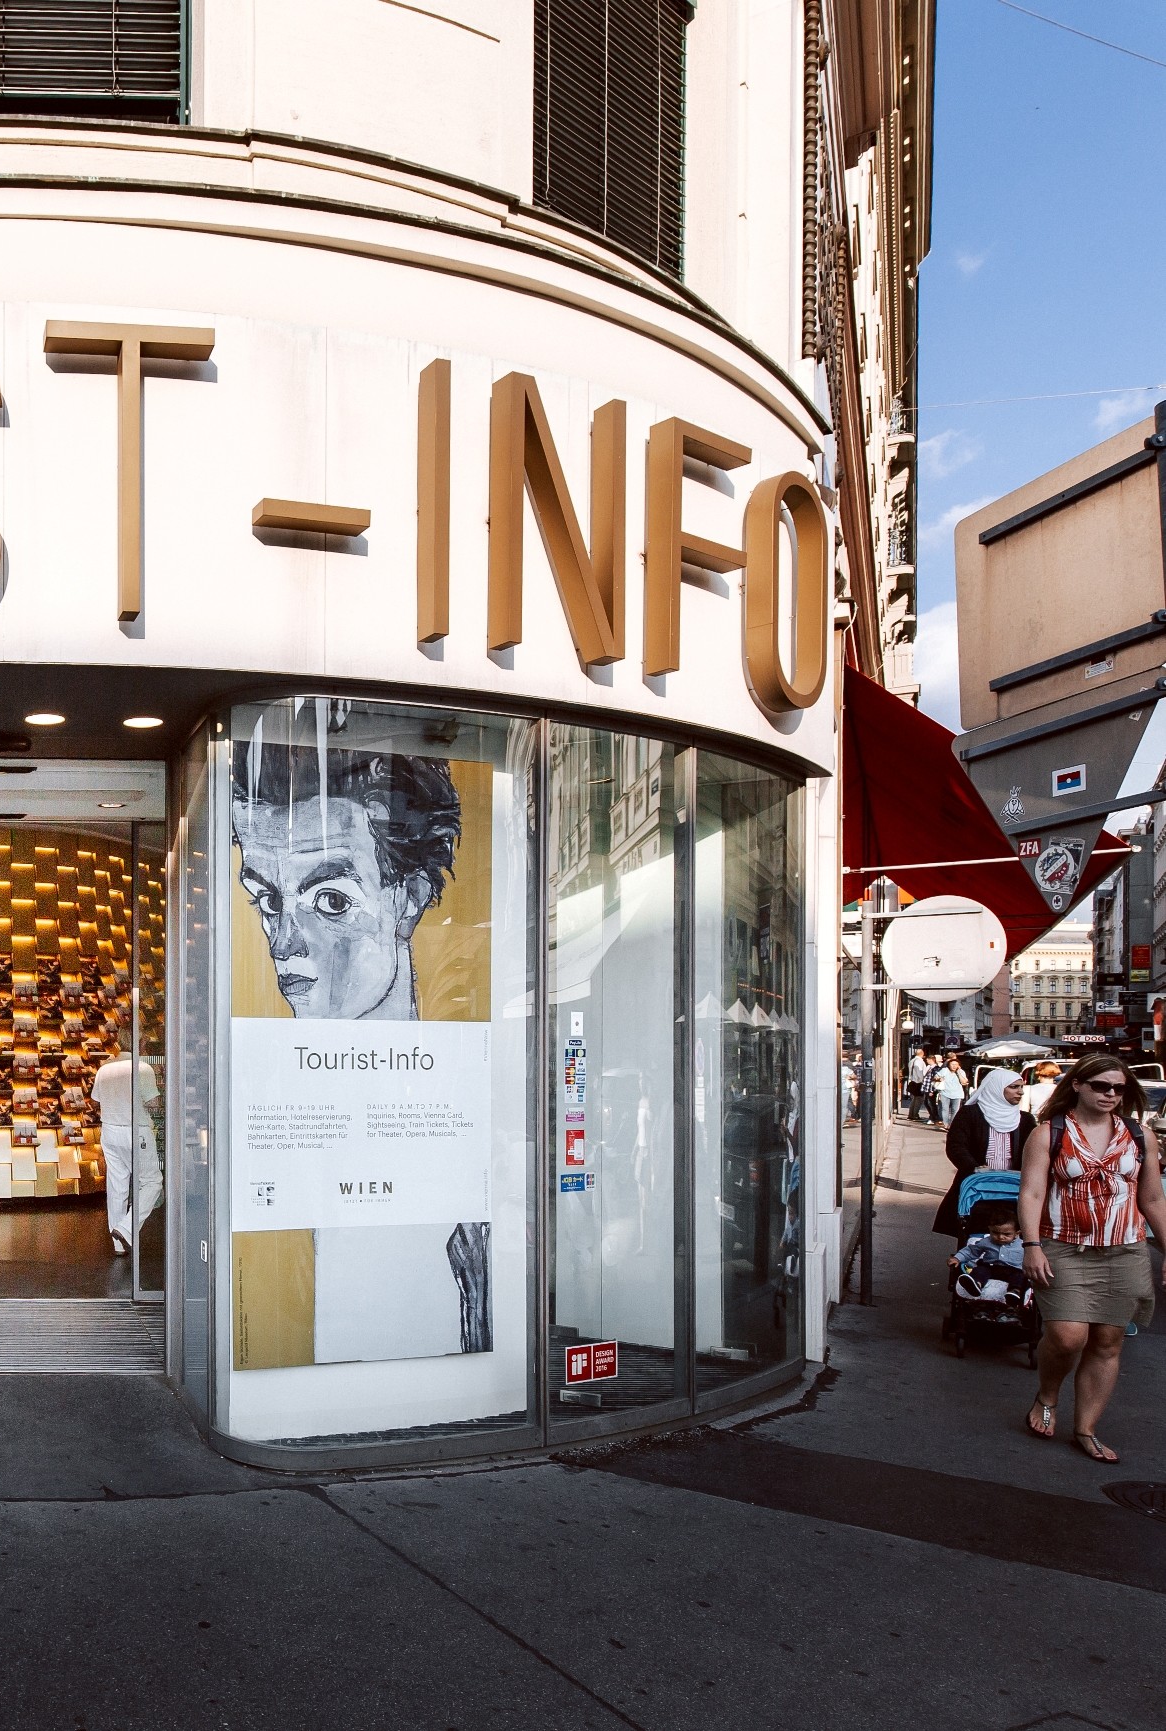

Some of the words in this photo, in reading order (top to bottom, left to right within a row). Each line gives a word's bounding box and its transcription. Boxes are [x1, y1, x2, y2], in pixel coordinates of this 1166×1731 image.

[1019, 840, 1040, 856] ZFA
[294, 1046, 434, 1071] Tourist-Info
[423, 1111, 446, 1119] Vienna
[451, 1120, 474, 1128] Tickets
[289, 1132, 337, 1140] Eintrittskarten
[338, 1131, 348, 1139] für
[366, 1130, 376, 1138] for
[339, 1181, 393, 1195] WIEN
[595, 1349, 614, 1358] DESIGN
[571, 1352, 588, 1376] iF
[595, 1356, 615, 1365] AWARD
[595, 1364, 608, 1372] 2016
